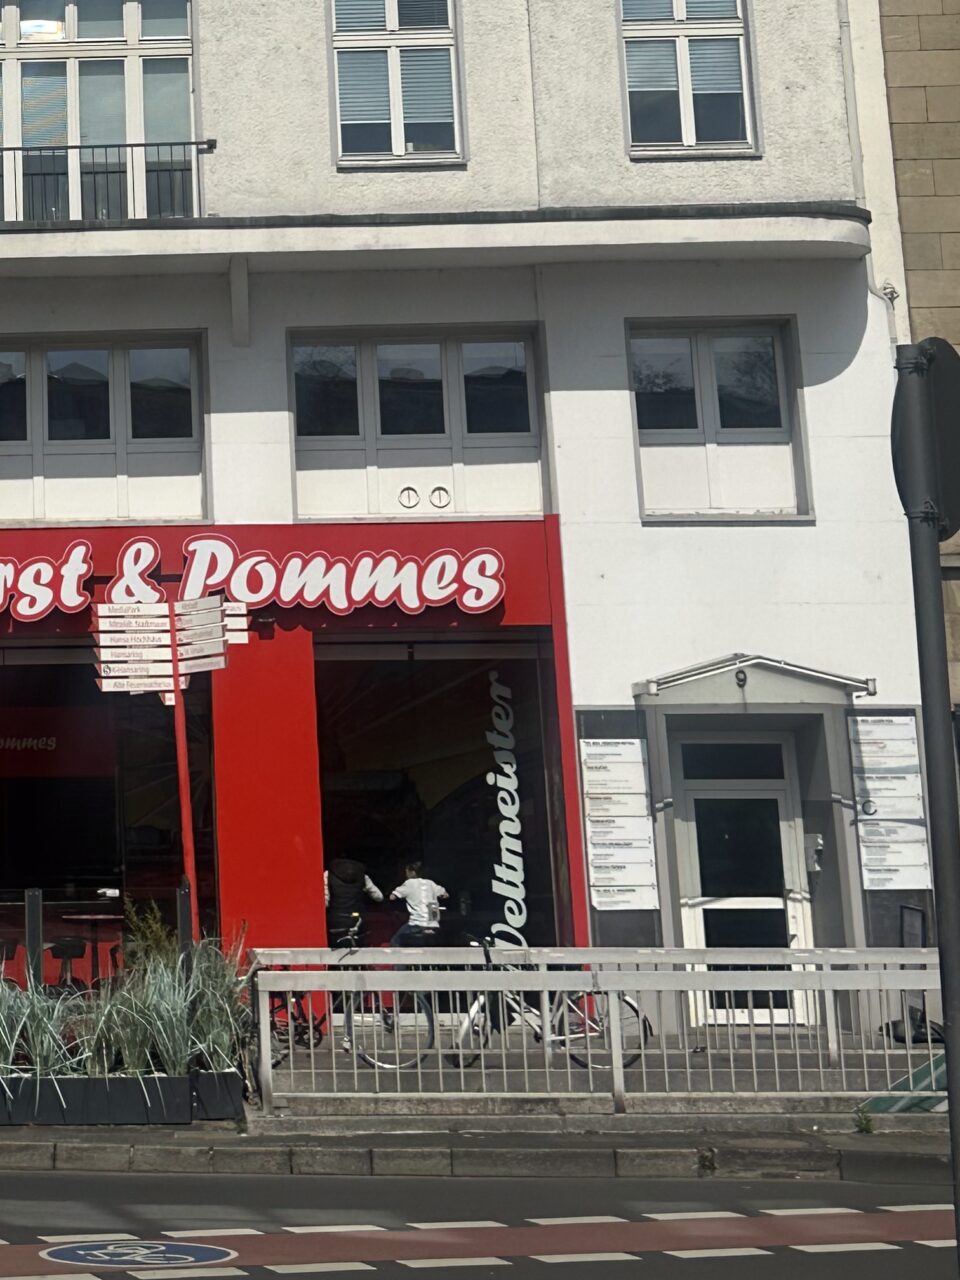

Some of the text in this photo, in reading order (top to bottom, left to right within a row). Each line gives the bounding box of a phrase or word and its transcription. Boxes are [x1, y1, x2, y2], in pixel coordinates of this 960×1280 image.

[110, 541, 161, 604] &
[182, 539, 500, 609] Pommes
[735, 669, 748, 689] 9
